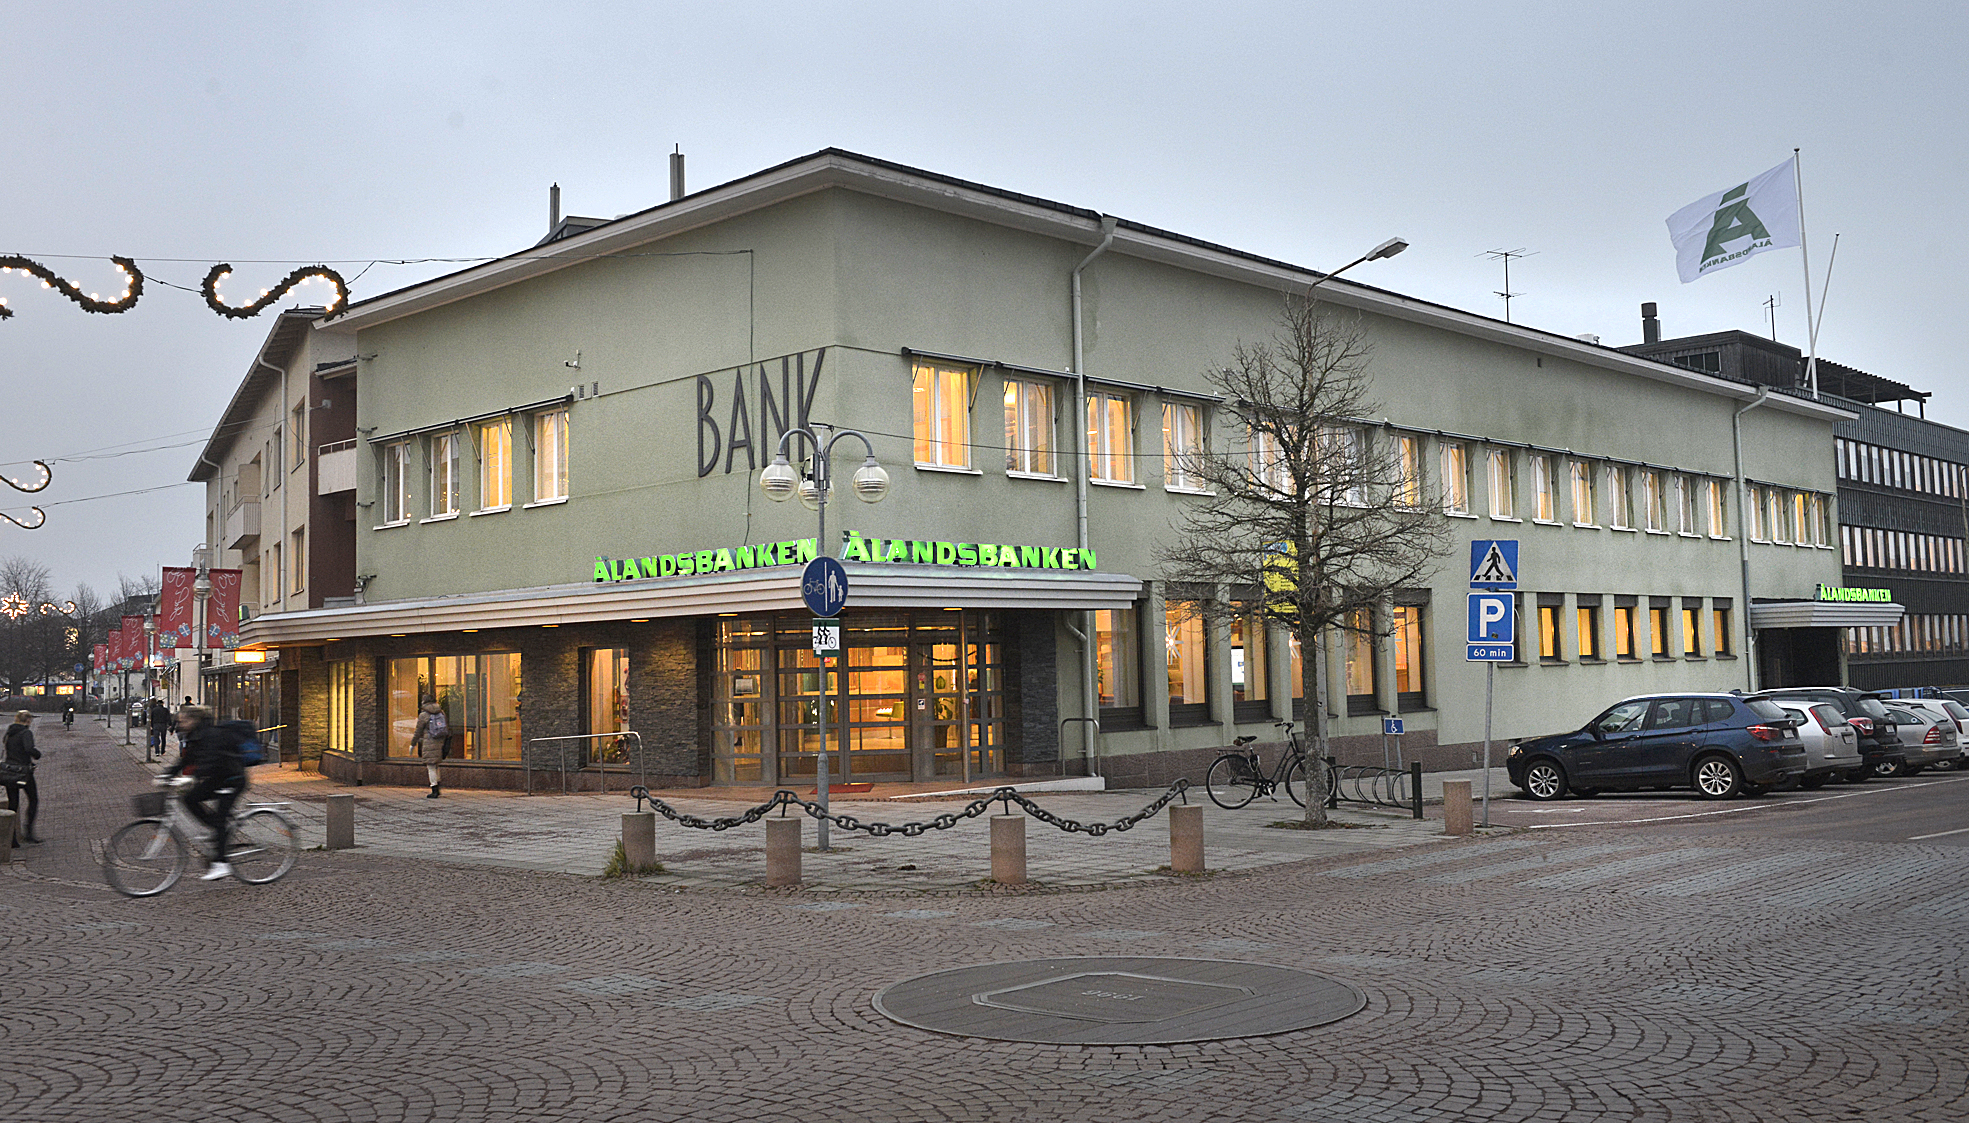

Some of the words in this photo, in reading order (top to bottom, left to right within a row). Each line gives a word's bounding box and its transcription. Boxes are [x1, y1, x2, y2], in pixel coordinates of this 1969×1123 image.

[697, 347, 826, 477] BANK
[592, 538, 818, 583] ÅLANDSBANKEN
[846, 530, 1097, 570] ÅLANDSBANKEN
[1820, 583, 1892, 603] ÅLANDSBANKEN
[1479, 598, 1506, 638] P
[1473, 648, 1486, 657] 60
[1489, 648, 1507, 657] min
